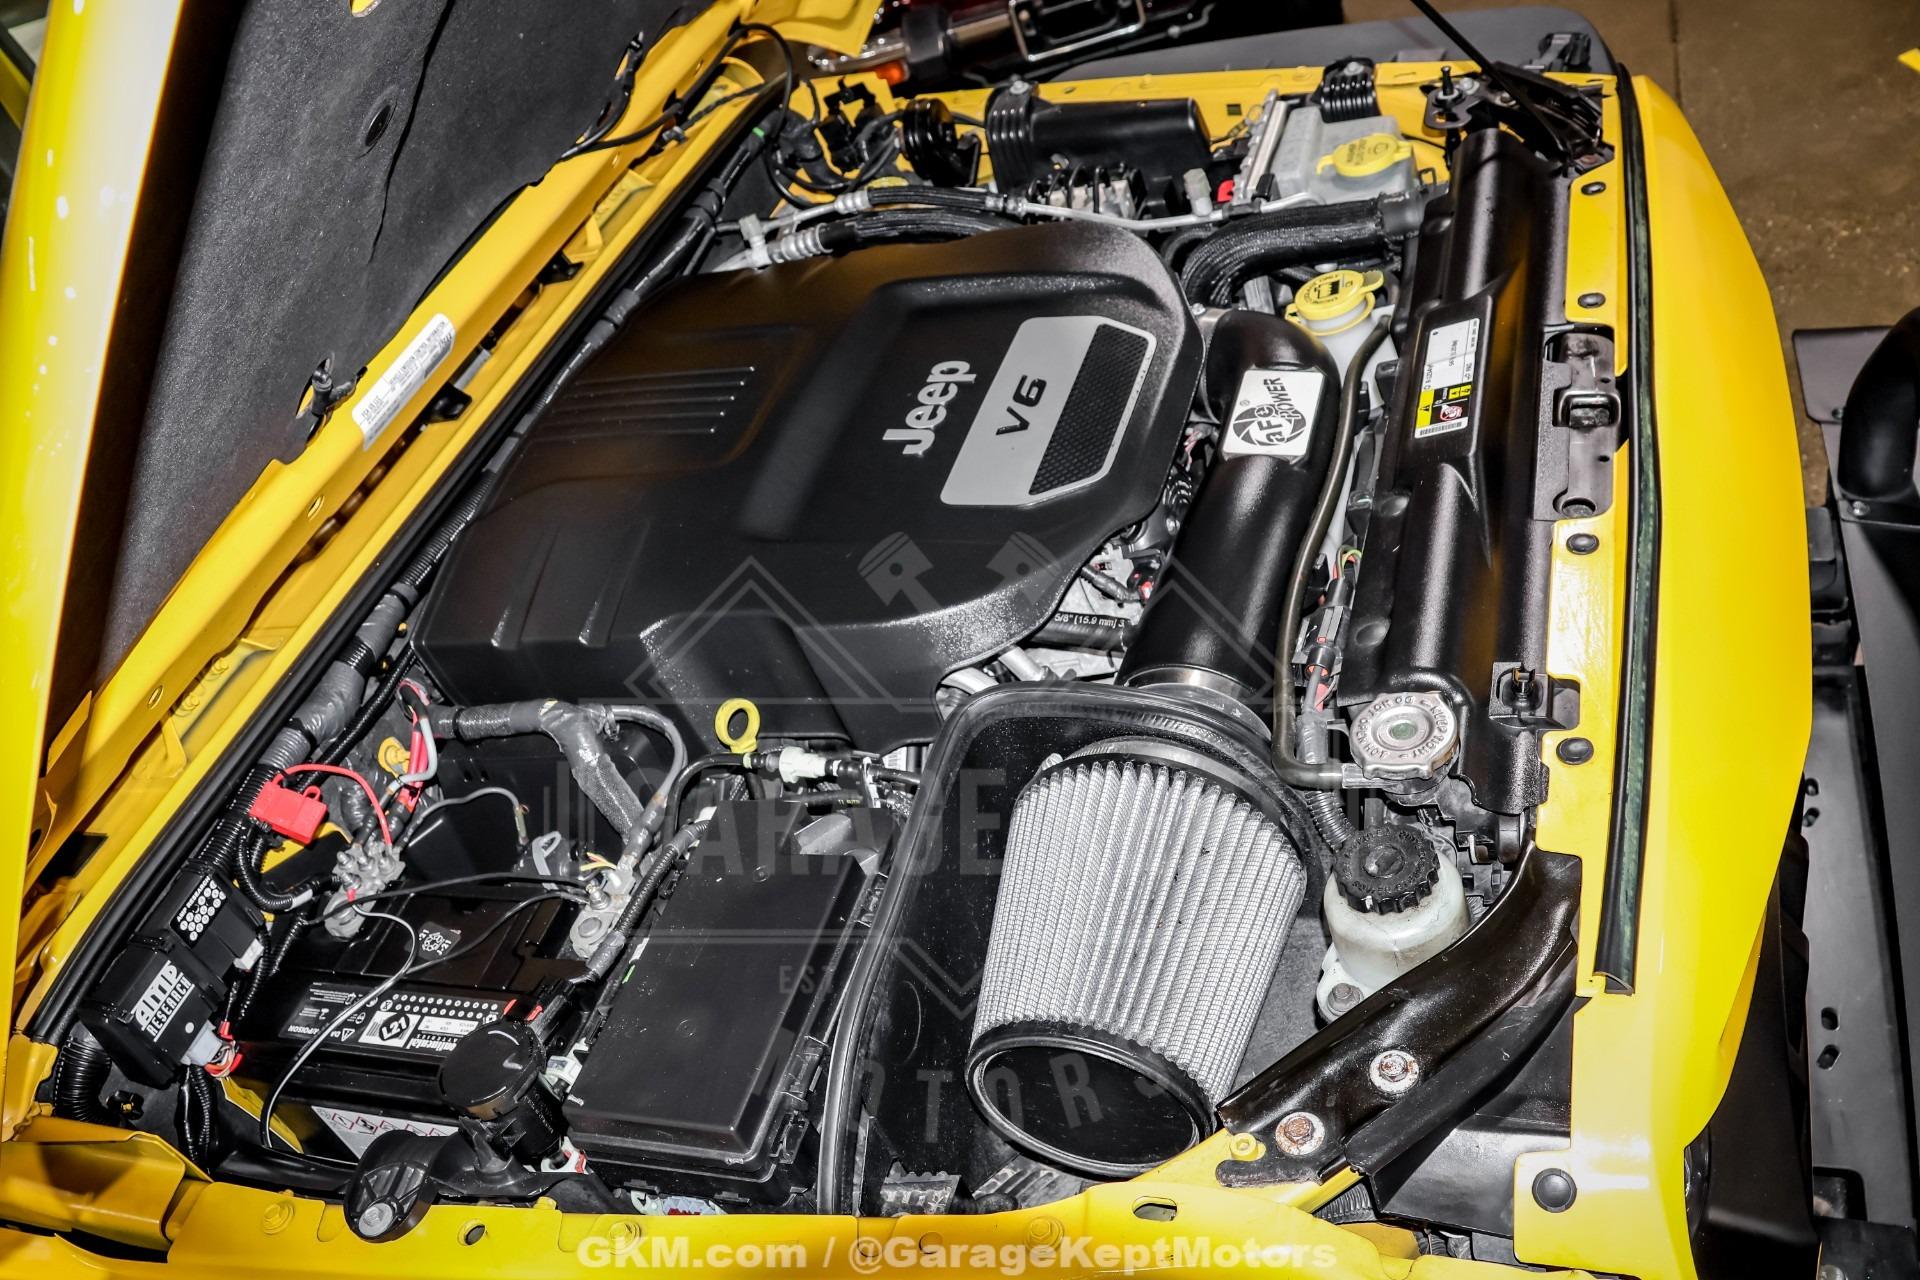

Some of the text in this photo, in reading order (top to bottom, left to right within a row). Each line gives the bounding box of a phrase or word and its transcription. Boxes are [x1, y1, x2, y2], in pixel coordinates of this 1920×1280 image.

[883, 361, 976, 456] Jeep
[996, 375, 1047, 436] V6
[1263, 378, 1302, 419] POWER
[1054, 613, 1074, 623] 5/8"
[1363, 743, 1388, 758] HOT
[176, 906, 188, 923] AMP
[186, 876, 211, 909] RESEARCH
[135, 963, 179, 1031] AMP
[146, 975, 192, 1037] RESEARCH
[381, 1016, 409, 1041] L21
[405, 1037, 458, 1051] ontinental
[416, 1033, 459, 1043] ATTERIES
